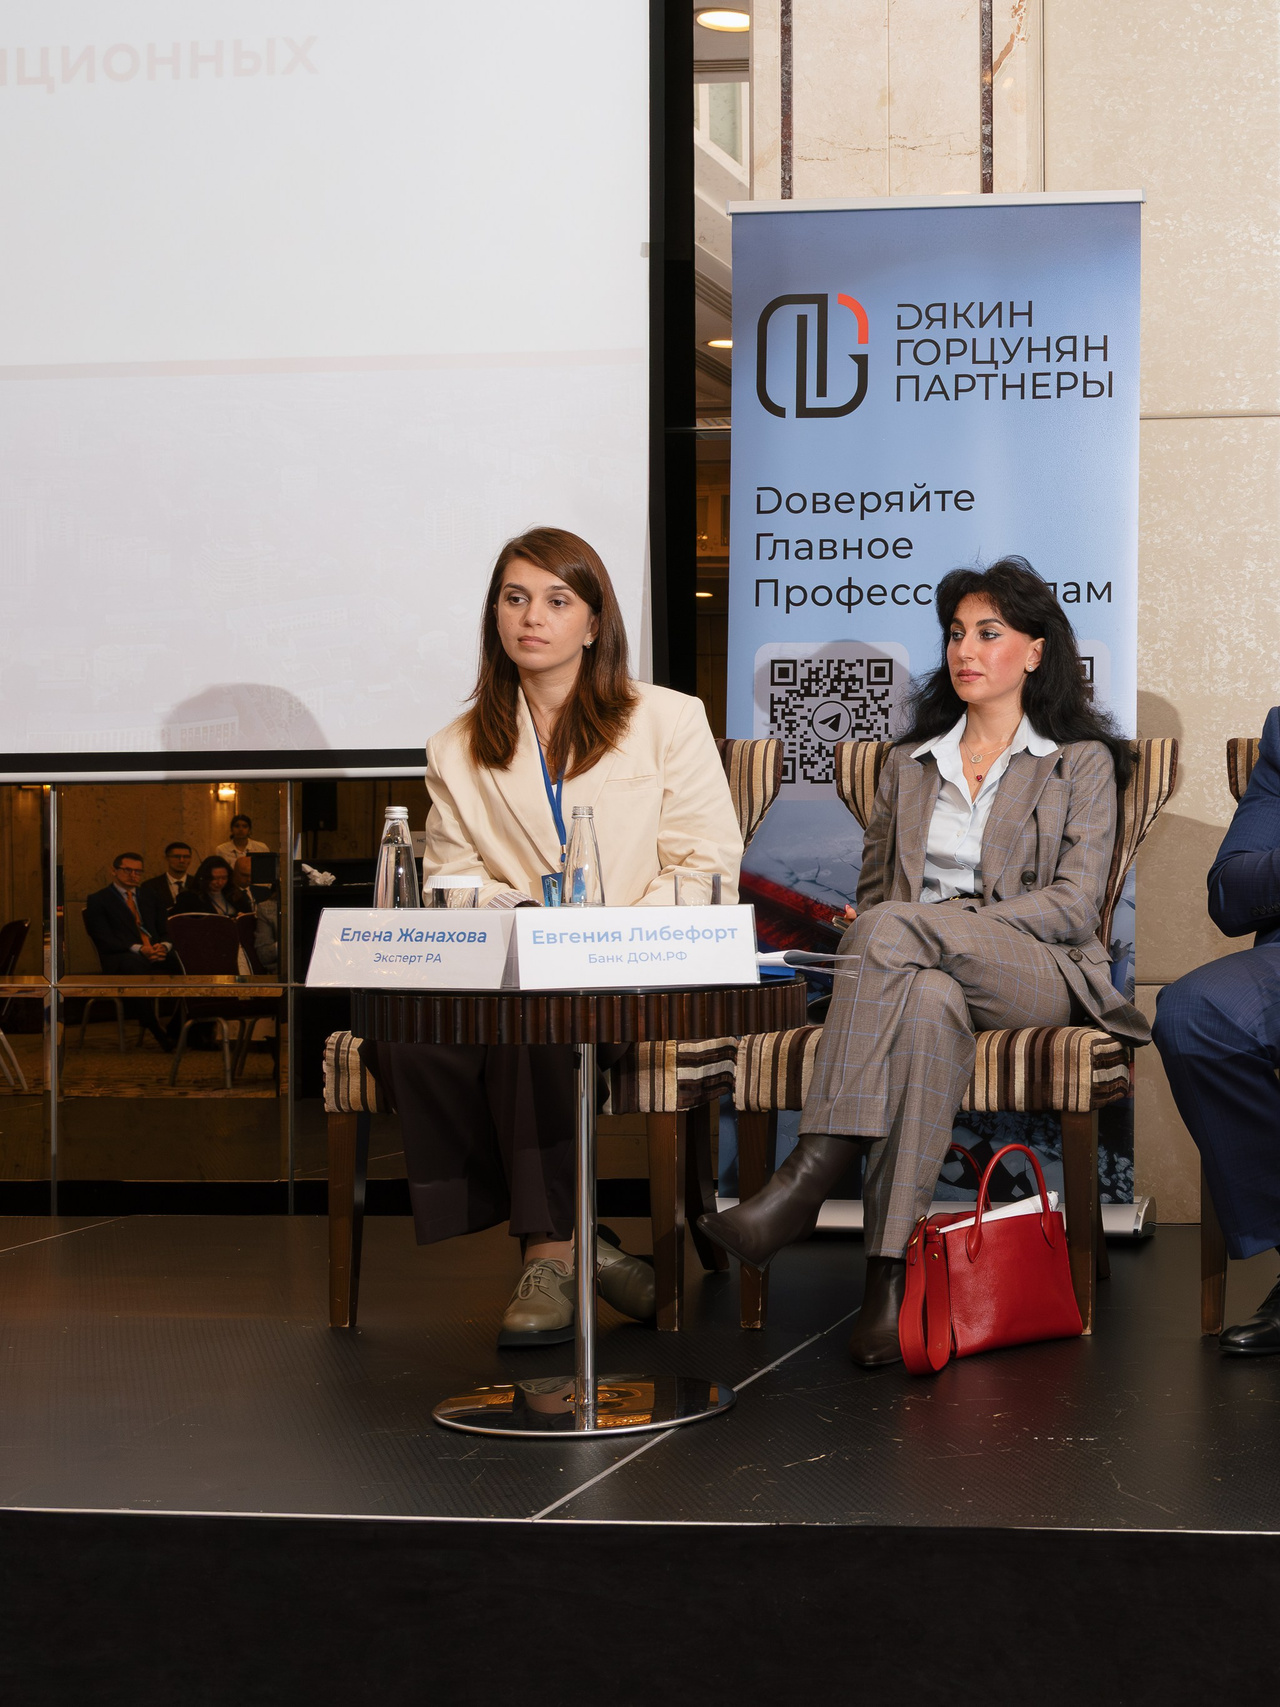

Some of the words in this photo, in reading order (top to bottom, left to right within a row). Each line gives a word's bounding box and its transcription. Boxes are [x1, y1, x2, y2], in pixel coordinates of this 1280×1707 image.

[897, 335, 1107, 370] ГОРЦУНЯН
[896, 371, 1113, 403] ПАРТНЕРЫ
[756, 533, 913, 560] Главное
[340, 927, 393, 943] Елена
[397, 928, 487, 944] Жанахова
[532, 929, 623, 945] Евгения
[628, 925, 737, 945] Либефорт
[373, 952, 423, 964] Эксперт
[425, 952, 442, 962] РА
[587, 952, 623, 964] Банк
[626, 951, 687, 964] ДОМ.РФ
